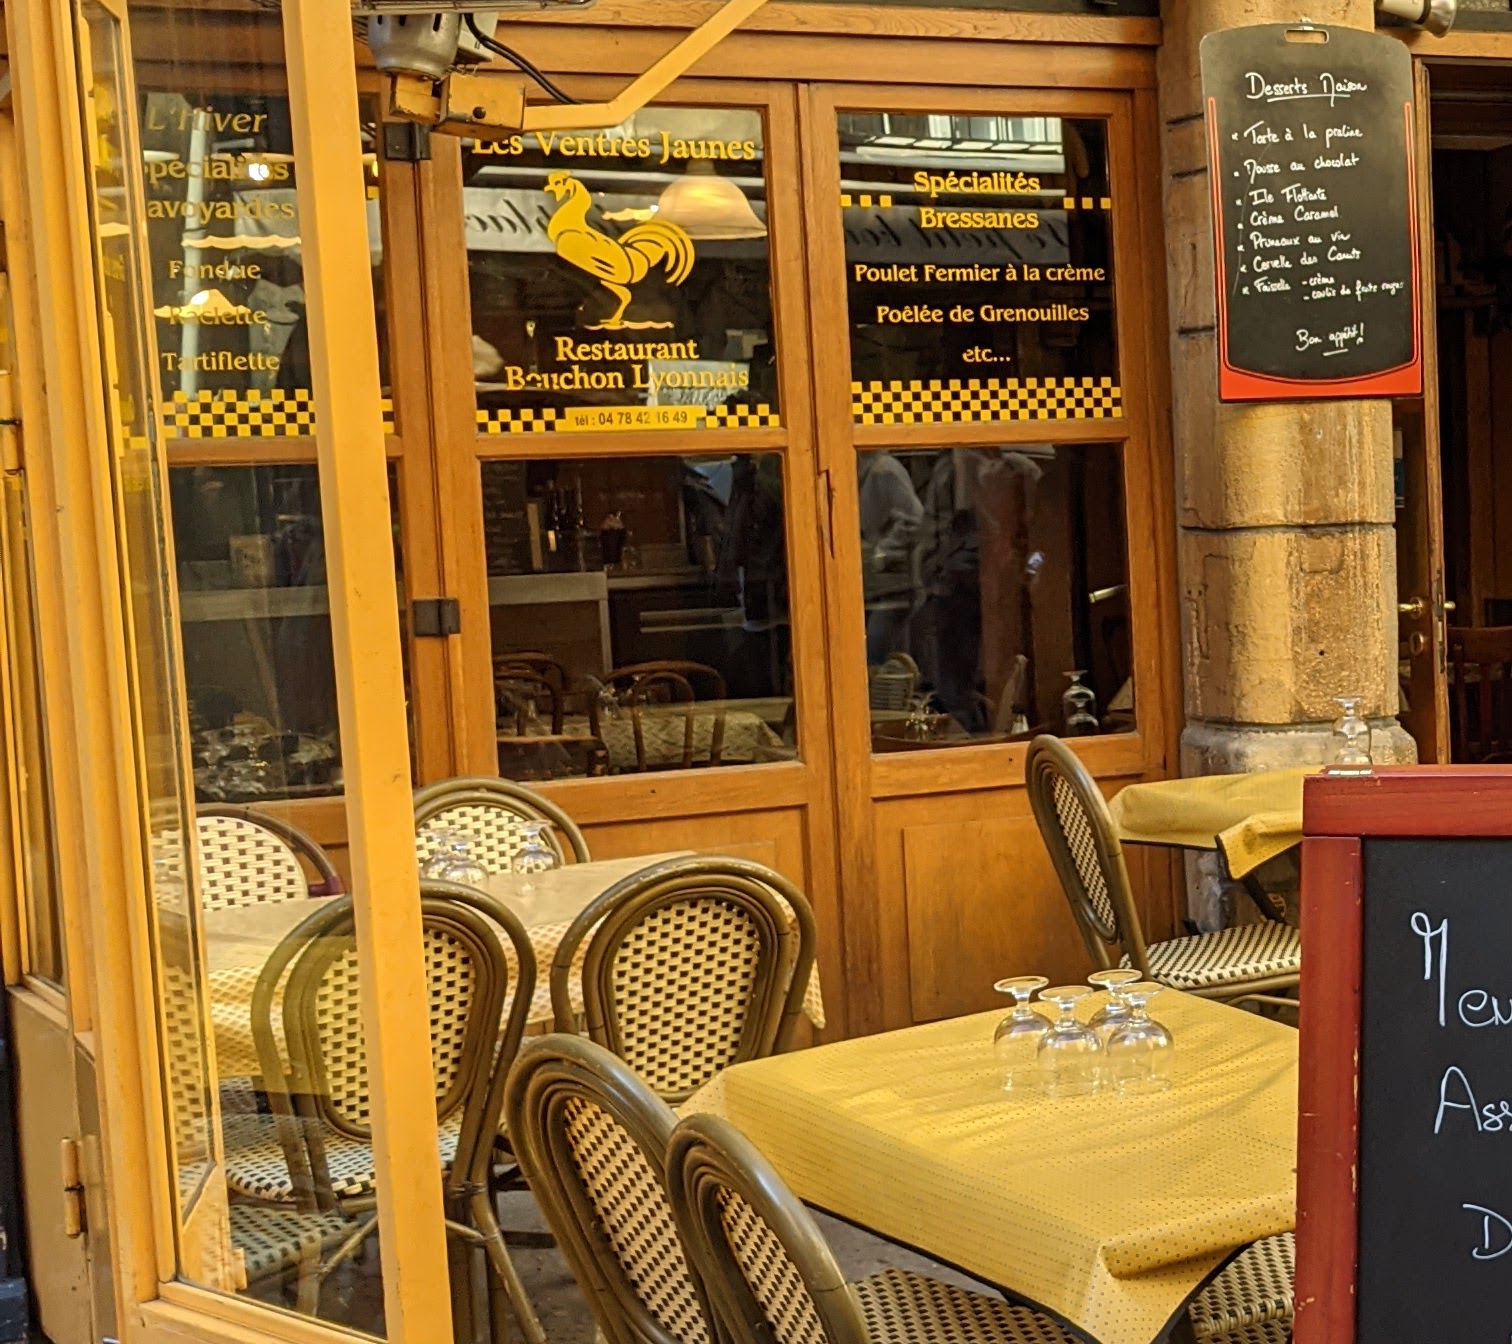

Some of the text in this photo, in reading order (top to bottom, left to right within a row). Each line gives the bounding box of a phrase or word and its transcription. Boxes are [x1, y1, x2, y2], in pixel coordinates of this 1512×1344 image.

[1245, 72, 1308, 99] Desserts
[1244, 120, 1280, 145] Tarte
[1303, 123, 1317, 139] la
[1325, 124, 1363, 148] praline
[535, 131, 651, 158] Ventres
[660, 131, 756, 164] Jaunes
[1290, 161, 1306, 171] au
[1314, 152, 1360, 169] chocolat
[913, 170, 1041, 198] Spécialités
[148, 197, 295, 224] avoyardes
[919, 207, 1040, 230] Bressanes
[1250, 205, 1339, 226] Crème Caramel
[1249, 231, 1300, 250] Pruneaux
[169, 259, 262, 280] Fondue
[854, 263, 1106, 282] Poulet Fermier à la crème
[1253, 255, 1293, 273] Cervelle
[1300, 252, 1318, 265] des
[169, 306, 268, 325] Raclette
[876, 304, 1090, 323] Poêlée de Grenouilles
[555, 336, 699, 361] Restaurant
[1295, 329, 1323, 351] Bon
[162, 351, 280, 371] Tartiflette
[962, 346, 1012, 363] etc...
[505, 363, 750, 396] Bouchon Lyonnais
[598, 412, 613, 426] 04
[617, 411, 633, 425] 78
[636, 411, 651, 425] 42
[656, 411, 669, 424] 16
[673, 410, 688, 424] 49
